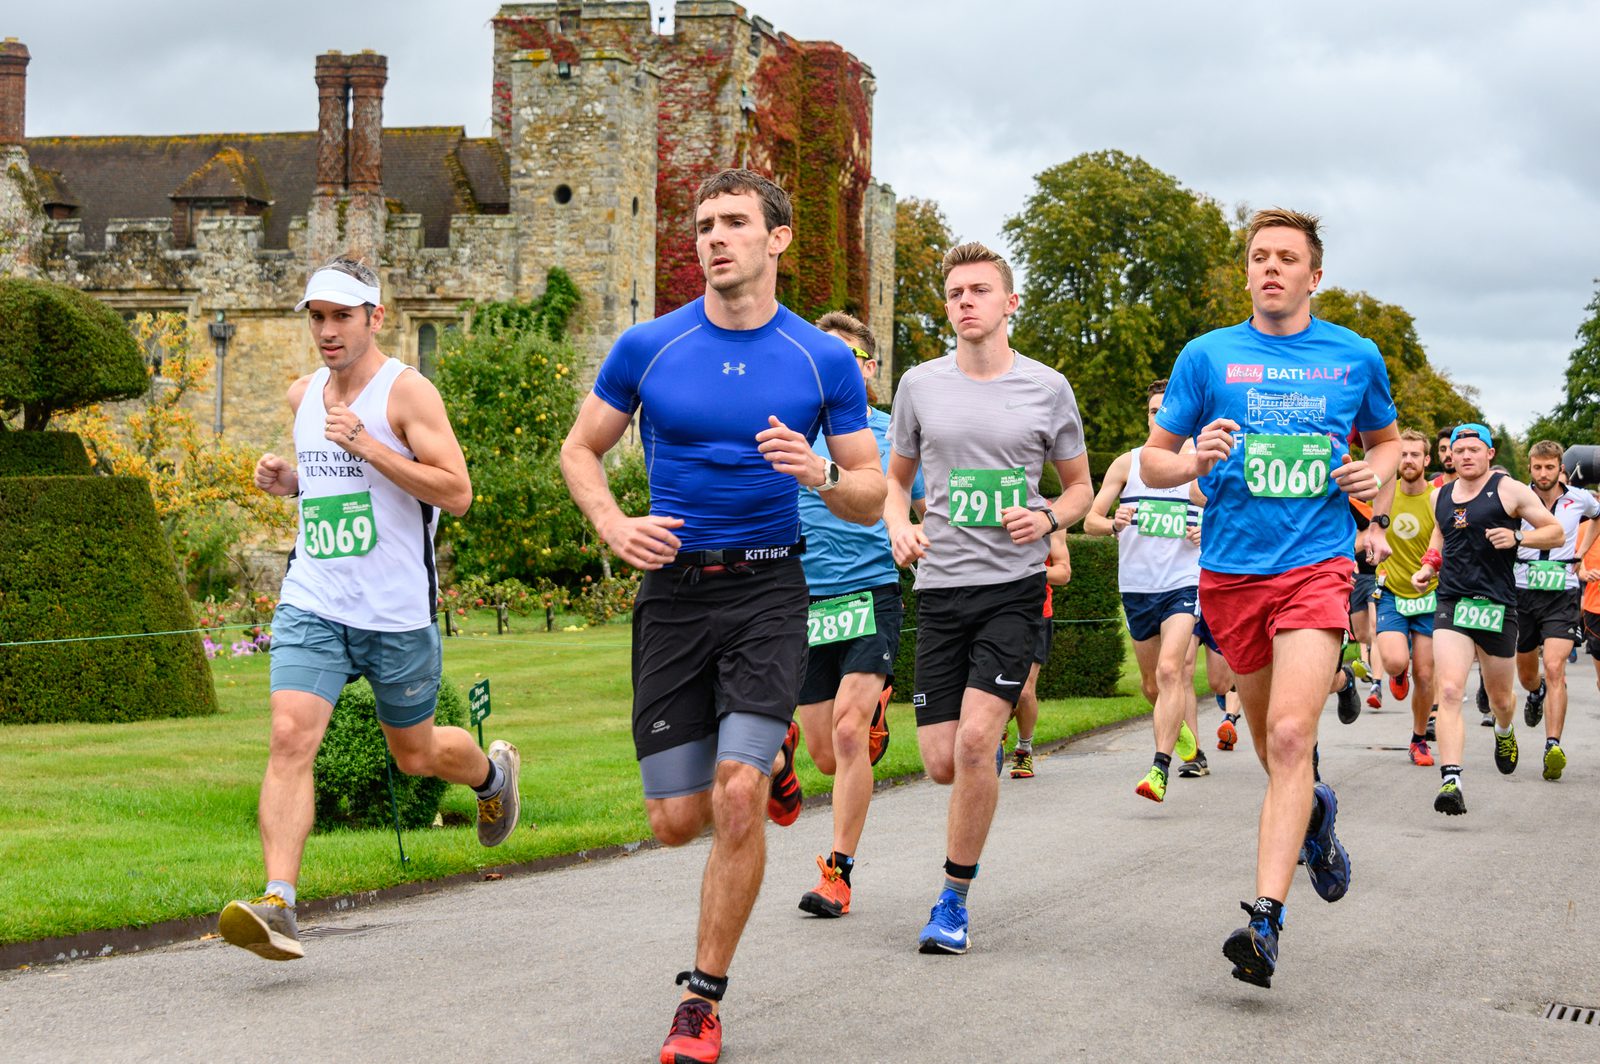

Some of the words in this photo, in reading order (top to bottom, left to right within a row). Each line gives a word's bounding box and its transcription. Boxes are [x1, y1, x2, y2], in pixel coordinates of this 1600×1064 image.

[332, 451, 368, 463] WOO
[305, 465, 364, 478] RUNNERS
[1247, 457, 1327, 495] 3060
[305, 515, 372, 556] 3069
[1139, 511, 1185, 536] 2790
[1529, 570, 1565, 588] 2977
[1397, 595, 1434, 614] 2807
[806, 606, 870, 644] 2897
[1456, 605, 1502, 629] 2962
